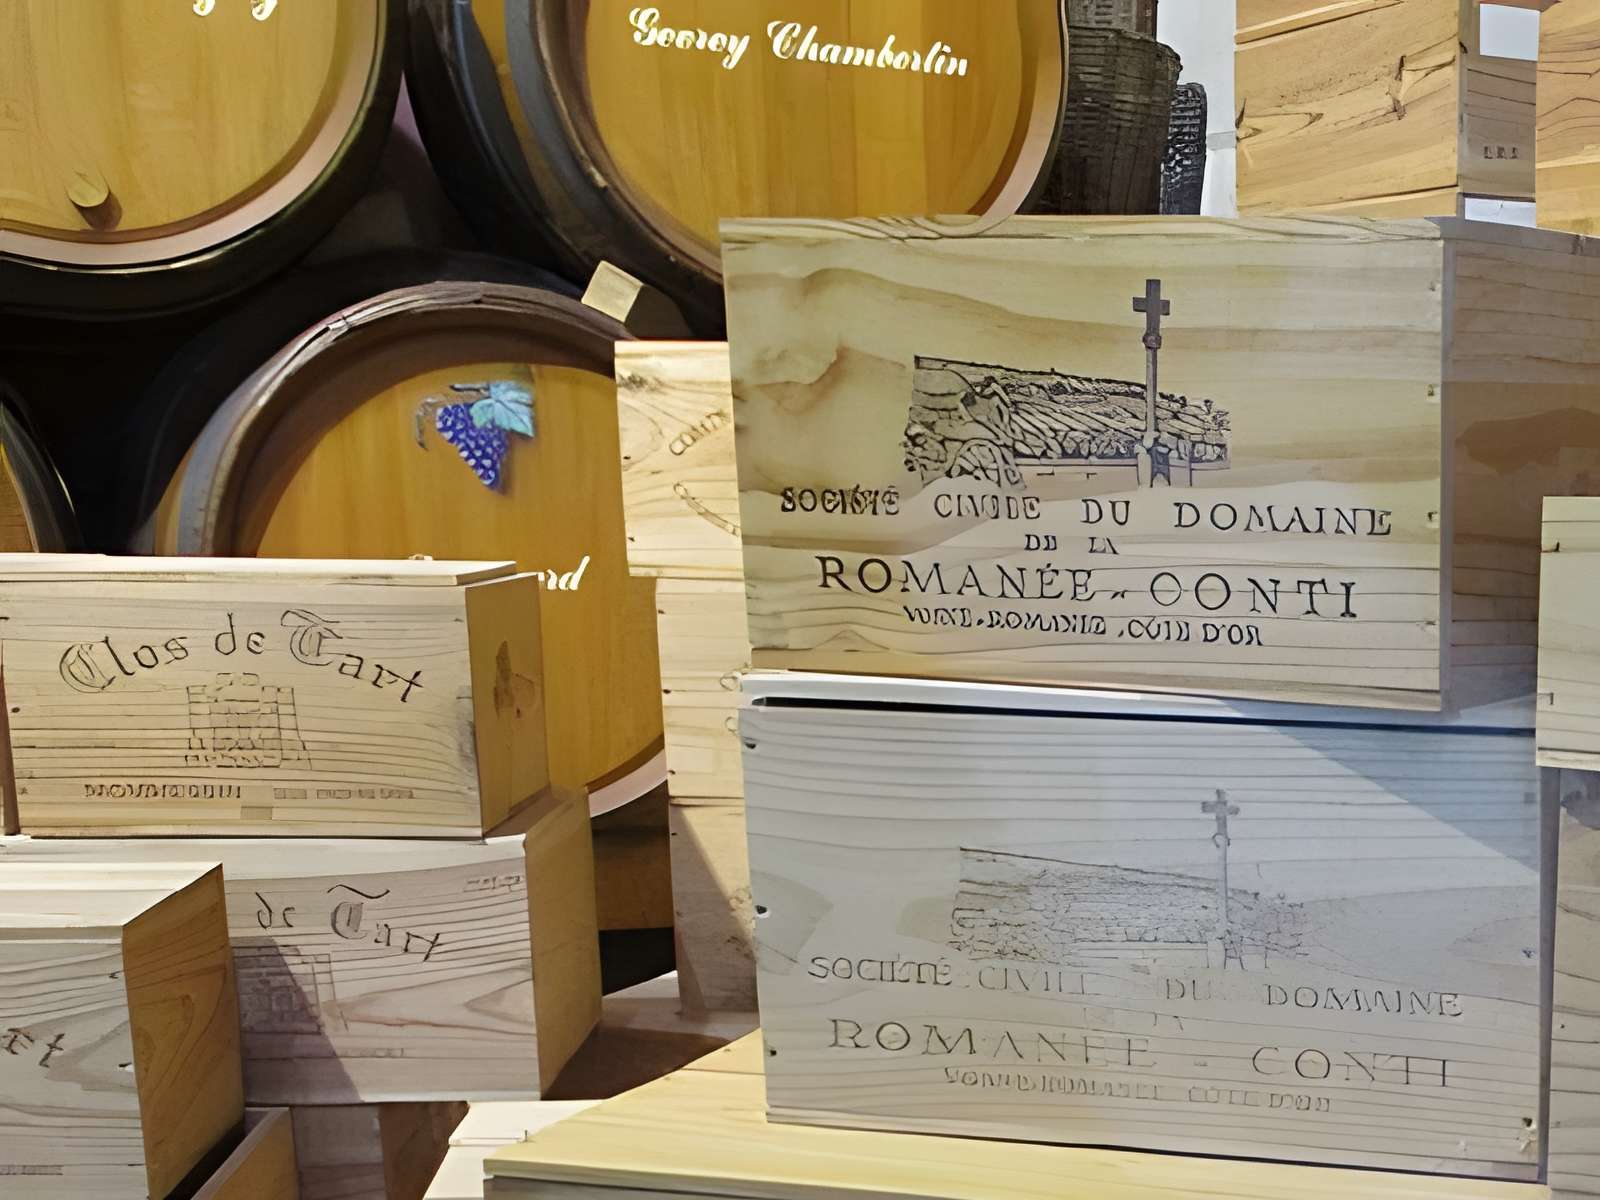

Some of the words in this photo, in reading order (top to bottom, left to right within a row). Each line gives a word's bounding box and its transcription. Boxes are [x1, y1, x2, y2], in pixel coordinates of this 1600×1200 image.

[1081, 500, 1131, 527] DU
[1173, 501, 1392, 537] DOMAINE
[58, 635, 190, 695] Clos
[213, 612, 266, 657] de
[279, 608, 425, 704] Tart
